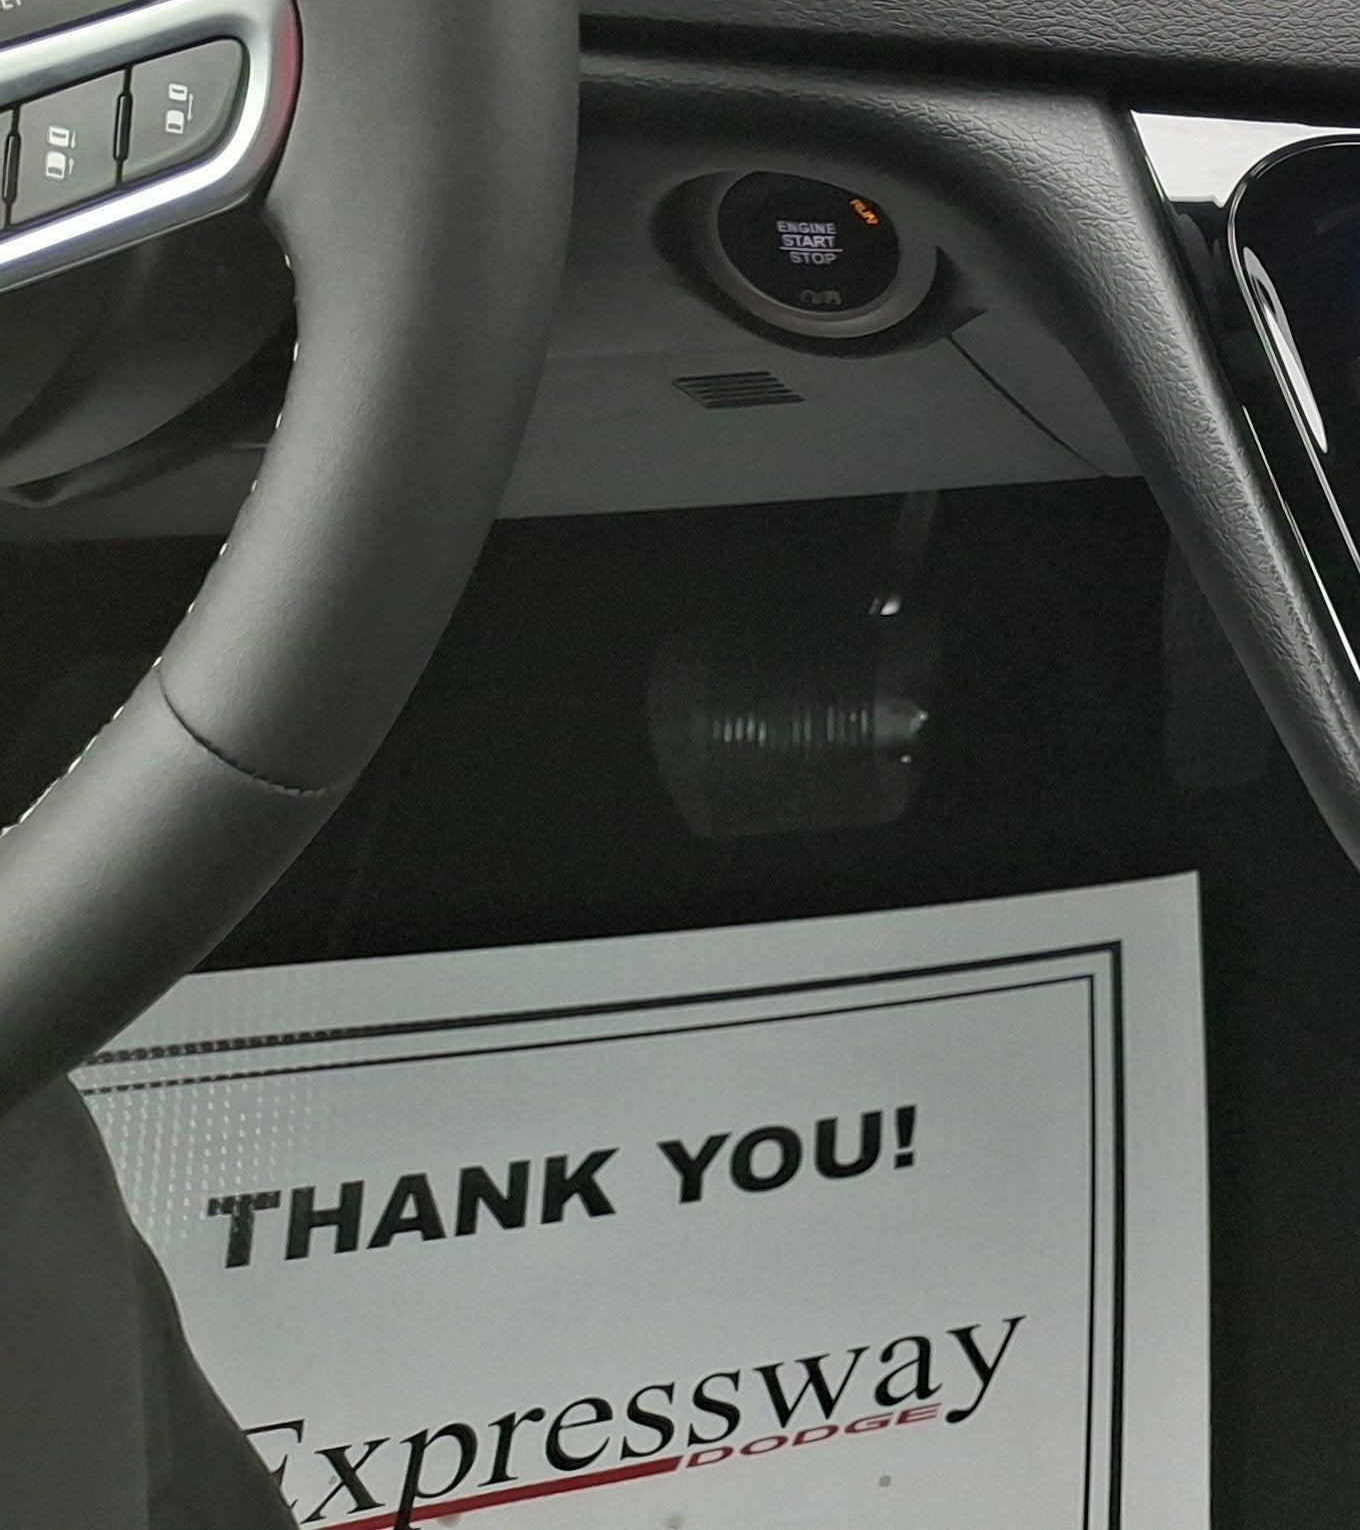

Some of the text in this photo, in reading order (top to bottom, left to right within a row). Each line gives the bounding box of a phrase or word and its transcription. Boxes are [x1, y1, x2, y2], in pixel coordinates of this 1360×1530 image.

[777, 220, 838, 234] ENGINE
[781, 234, 837, 248] START
[789, 251, 838, 264] STOP
[207, 1104, 919, 1271] THANK YOU!
[684, 1401, 942, 1470] DODGE
